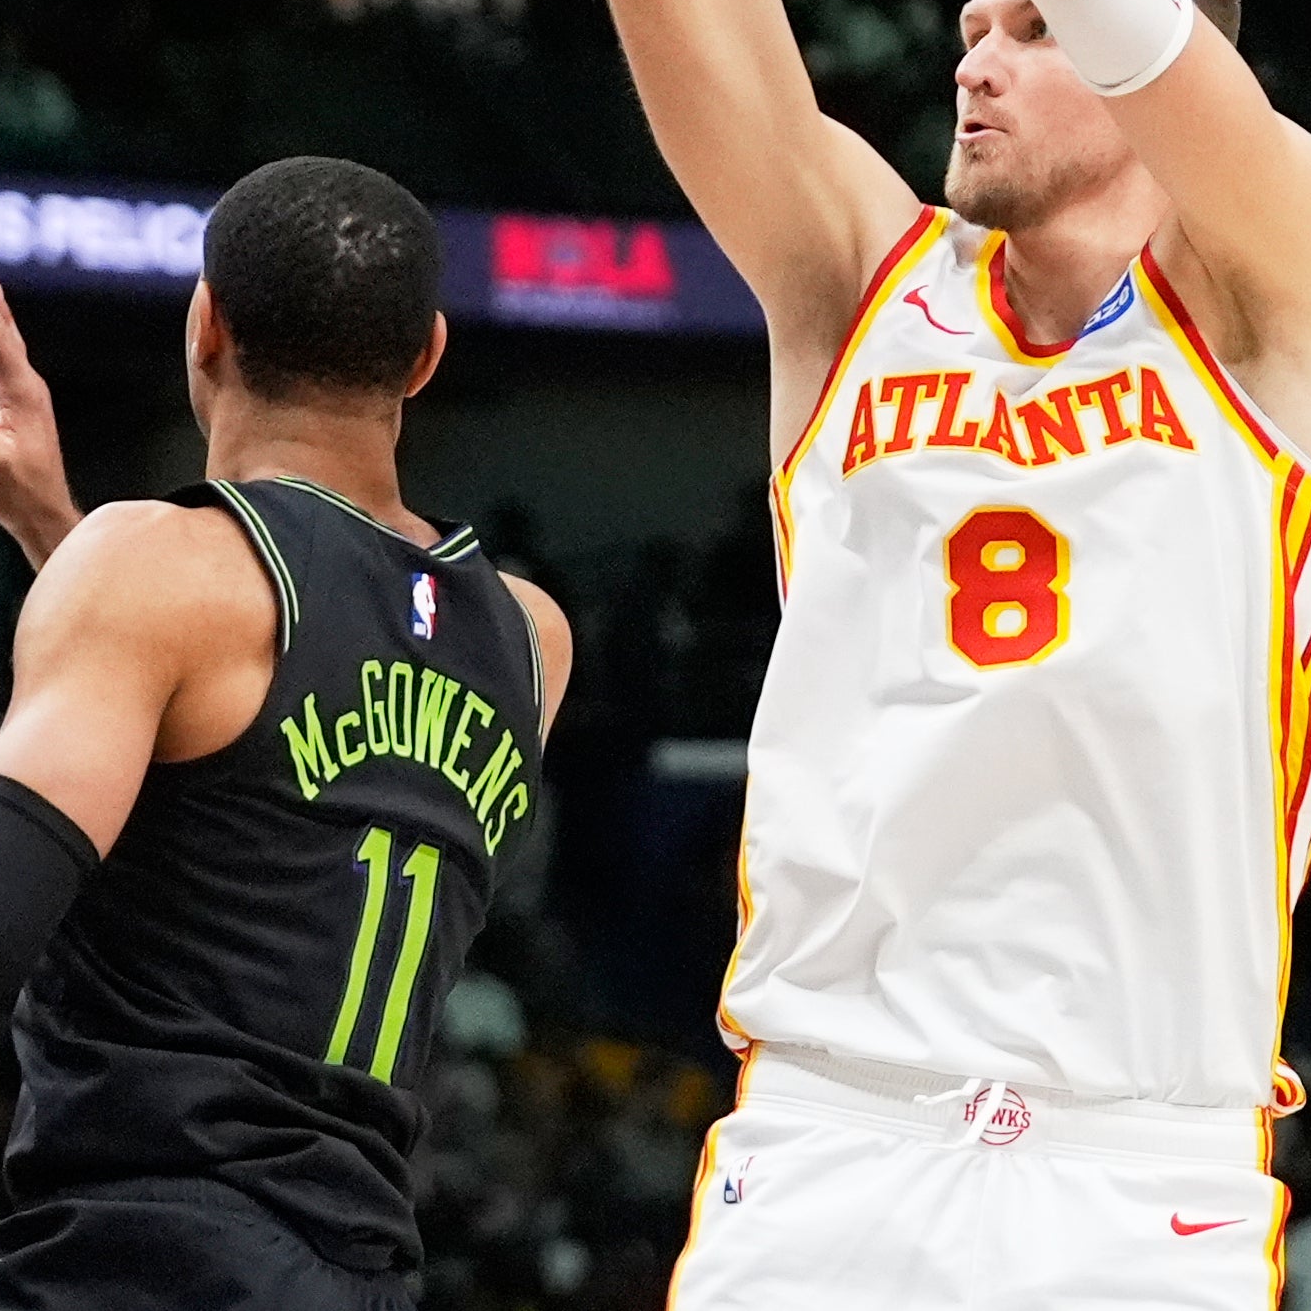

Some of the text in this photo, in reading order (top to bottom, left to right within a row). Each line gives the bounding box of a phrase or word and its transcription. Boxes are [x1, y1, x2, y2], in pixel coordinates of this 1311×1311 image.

[842, 366, 1197, 480] ATLANTA
[943, 504, 1070, 671] 8
[279, 658, 528, 857] McGOWENS
[323, 825, 440, 1087] 11
[964, 1103, 1031, 1129] HWKS
